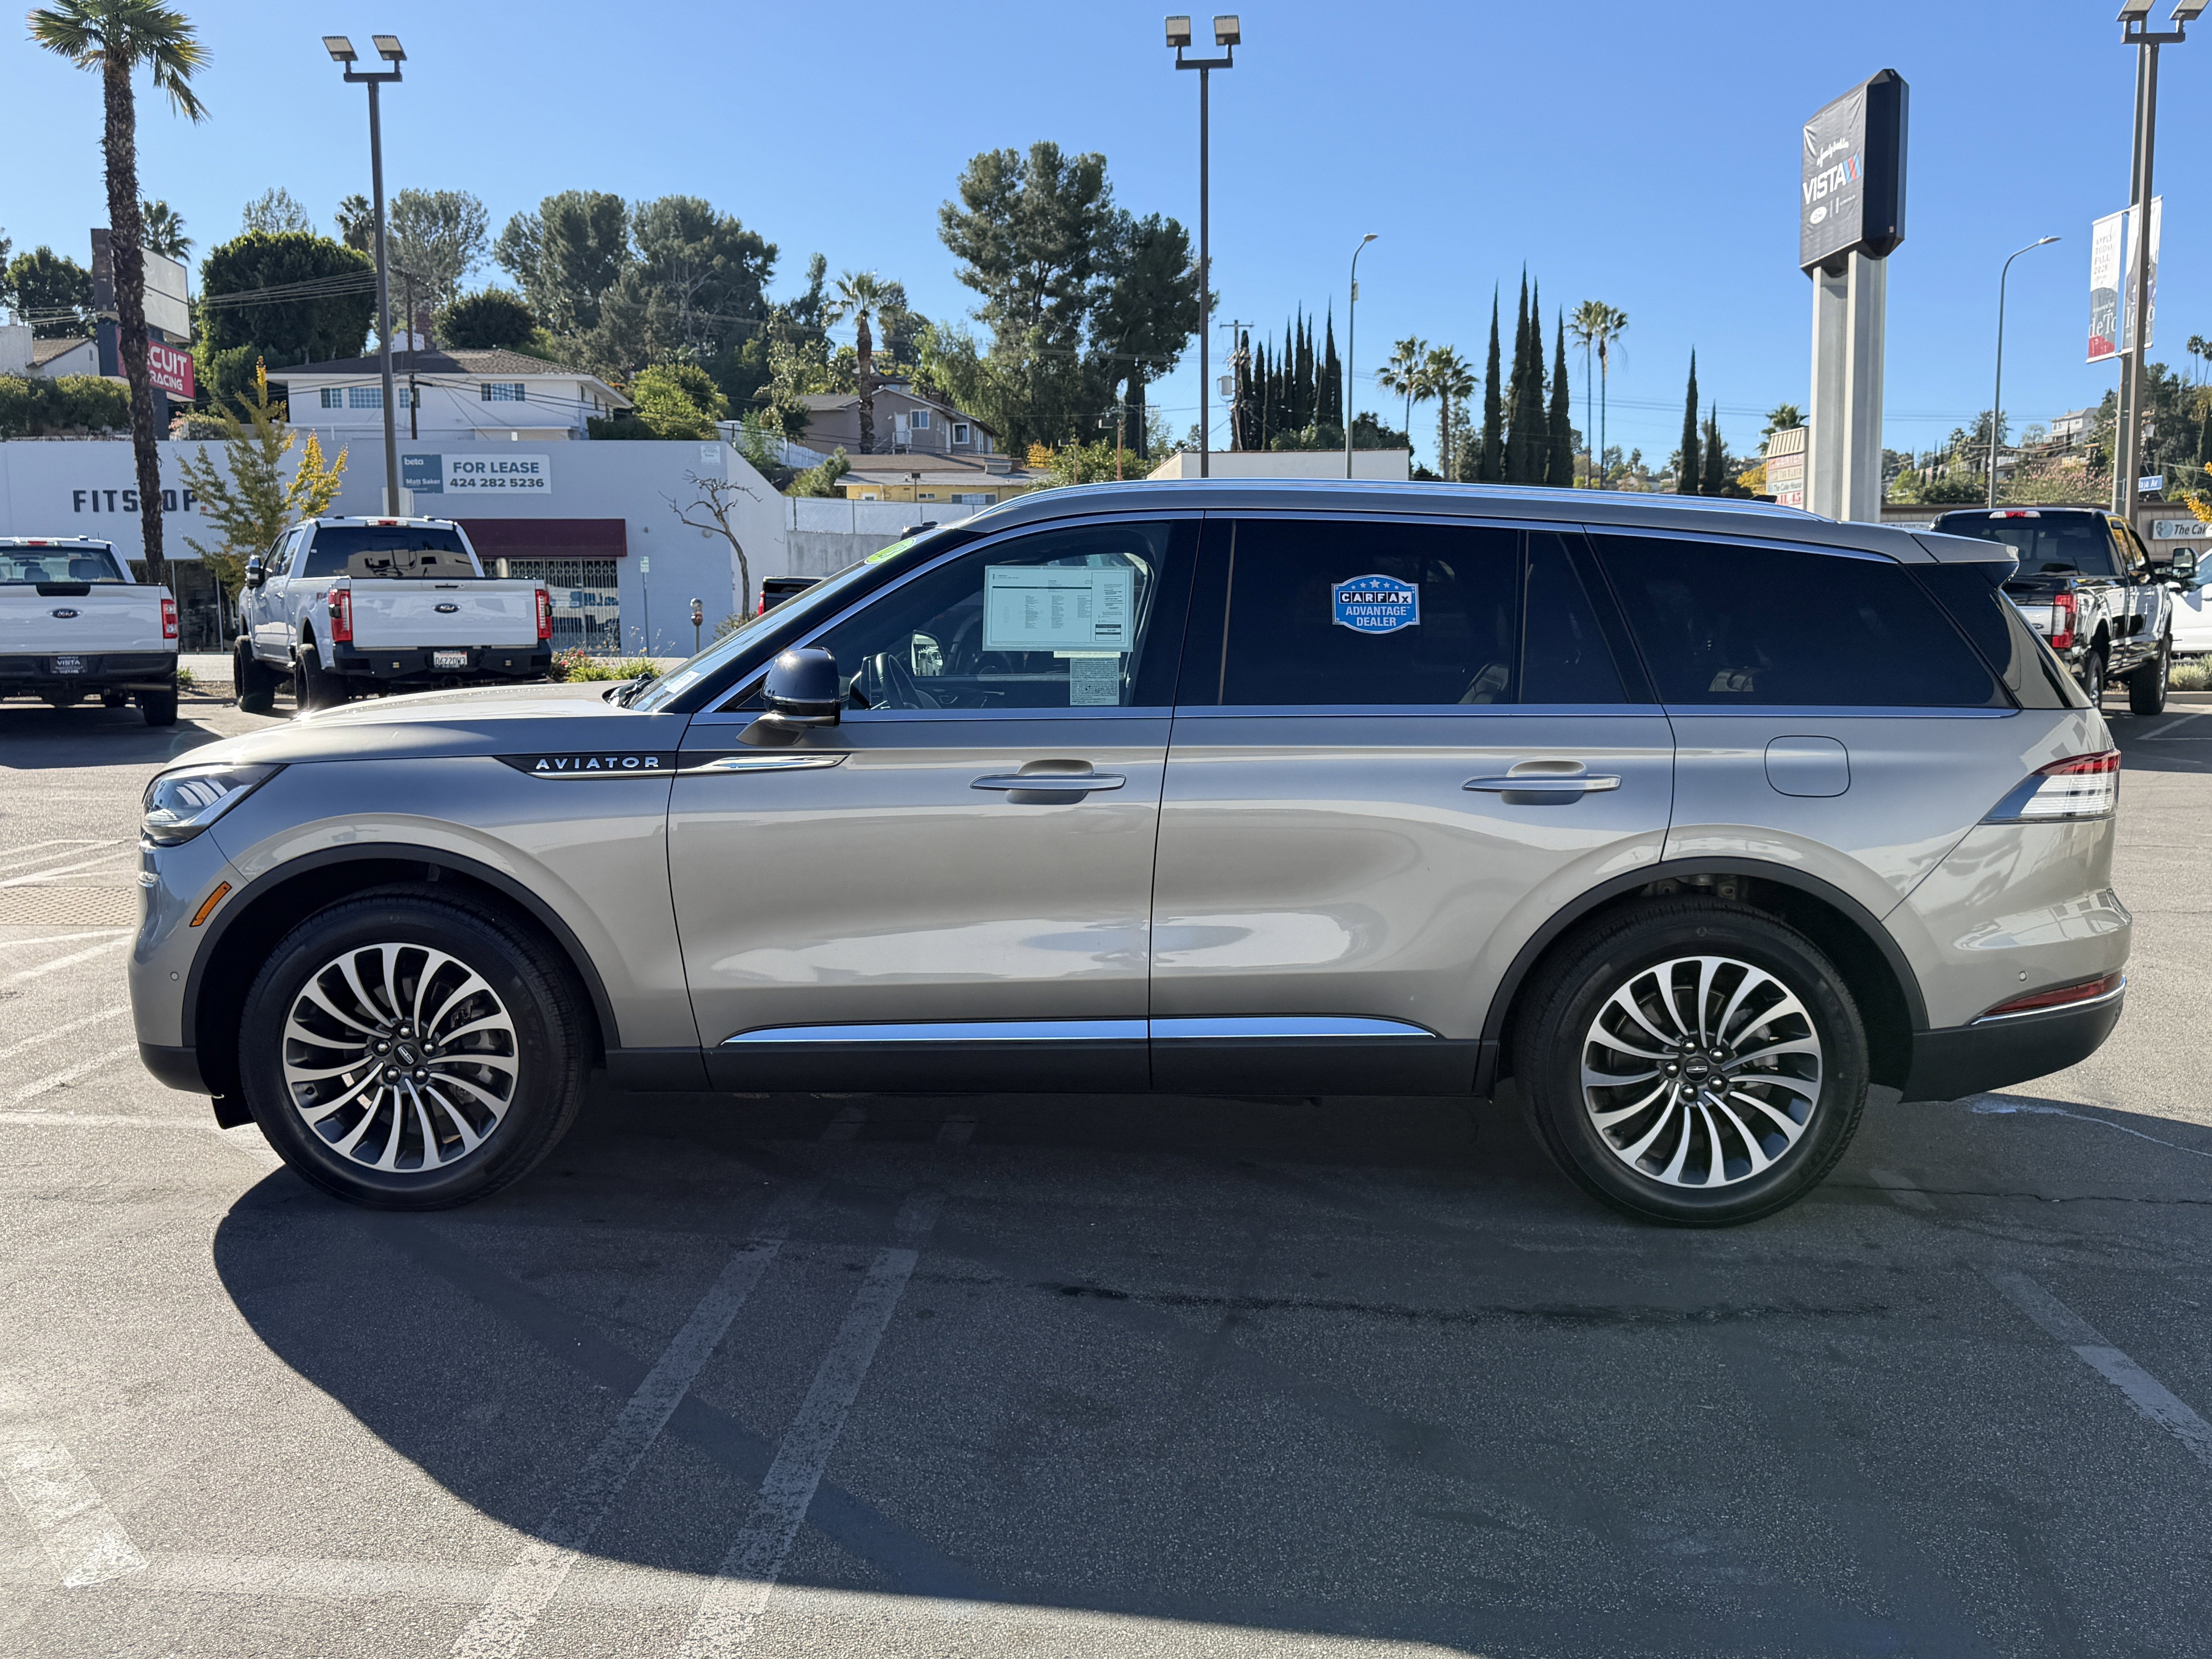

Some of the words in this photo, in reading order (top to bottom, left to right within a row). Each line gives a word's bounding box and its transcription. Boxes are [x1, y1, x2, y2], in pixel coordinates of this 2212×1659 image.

[1803, 163, 1846, 204] VISTA
[150, 346, 187, 377] CUIT
[453, 462, 485, 473] FOR
[490, 462, 539, 473] LEASE
[450, 478, 477, 487] 424
[480, 478, 506, 487] 282
[510, 478, 544, 487] 5236
[73, 489, 207, 512] FITSOP.
[2174, 524, 2190, 534] The
[2191, 524, 2207, 534] Cak
[1341, 592, 1410, 603] CARFAX
[1345, 606, 1407, 616] ADVANTAGE
[1356, 617, 1397, 627] DEALER
[535, 756, 659, 770] AVIATOR
